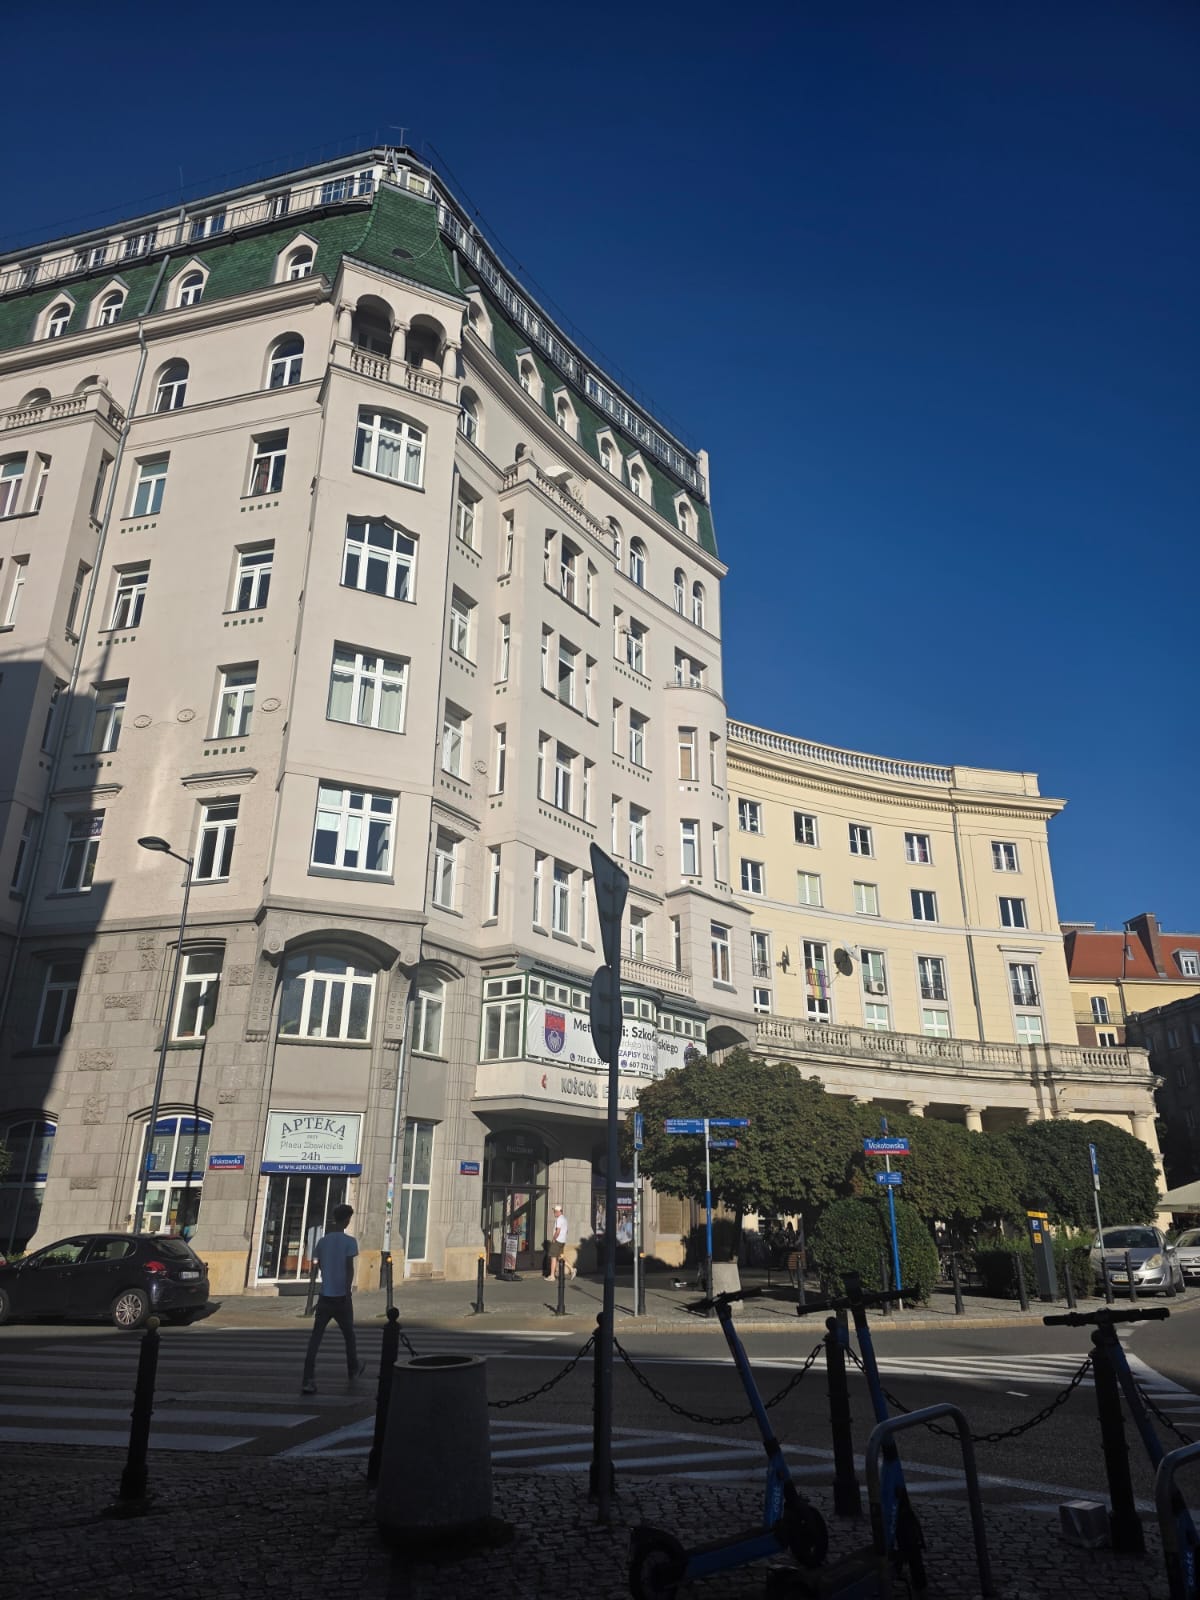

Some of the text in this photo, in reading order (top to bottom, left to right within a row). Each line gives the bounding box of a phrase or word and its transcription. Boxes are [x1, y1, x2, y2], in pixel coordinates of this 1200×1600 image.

[561, 1077, 598, 1099] KOŚCIÓŁ
[281, 1117, 346, 1138] APTEKA
[868, 1141, 905, 1150] Mokotowska
[301, 1151, 321, 1161] 24h
